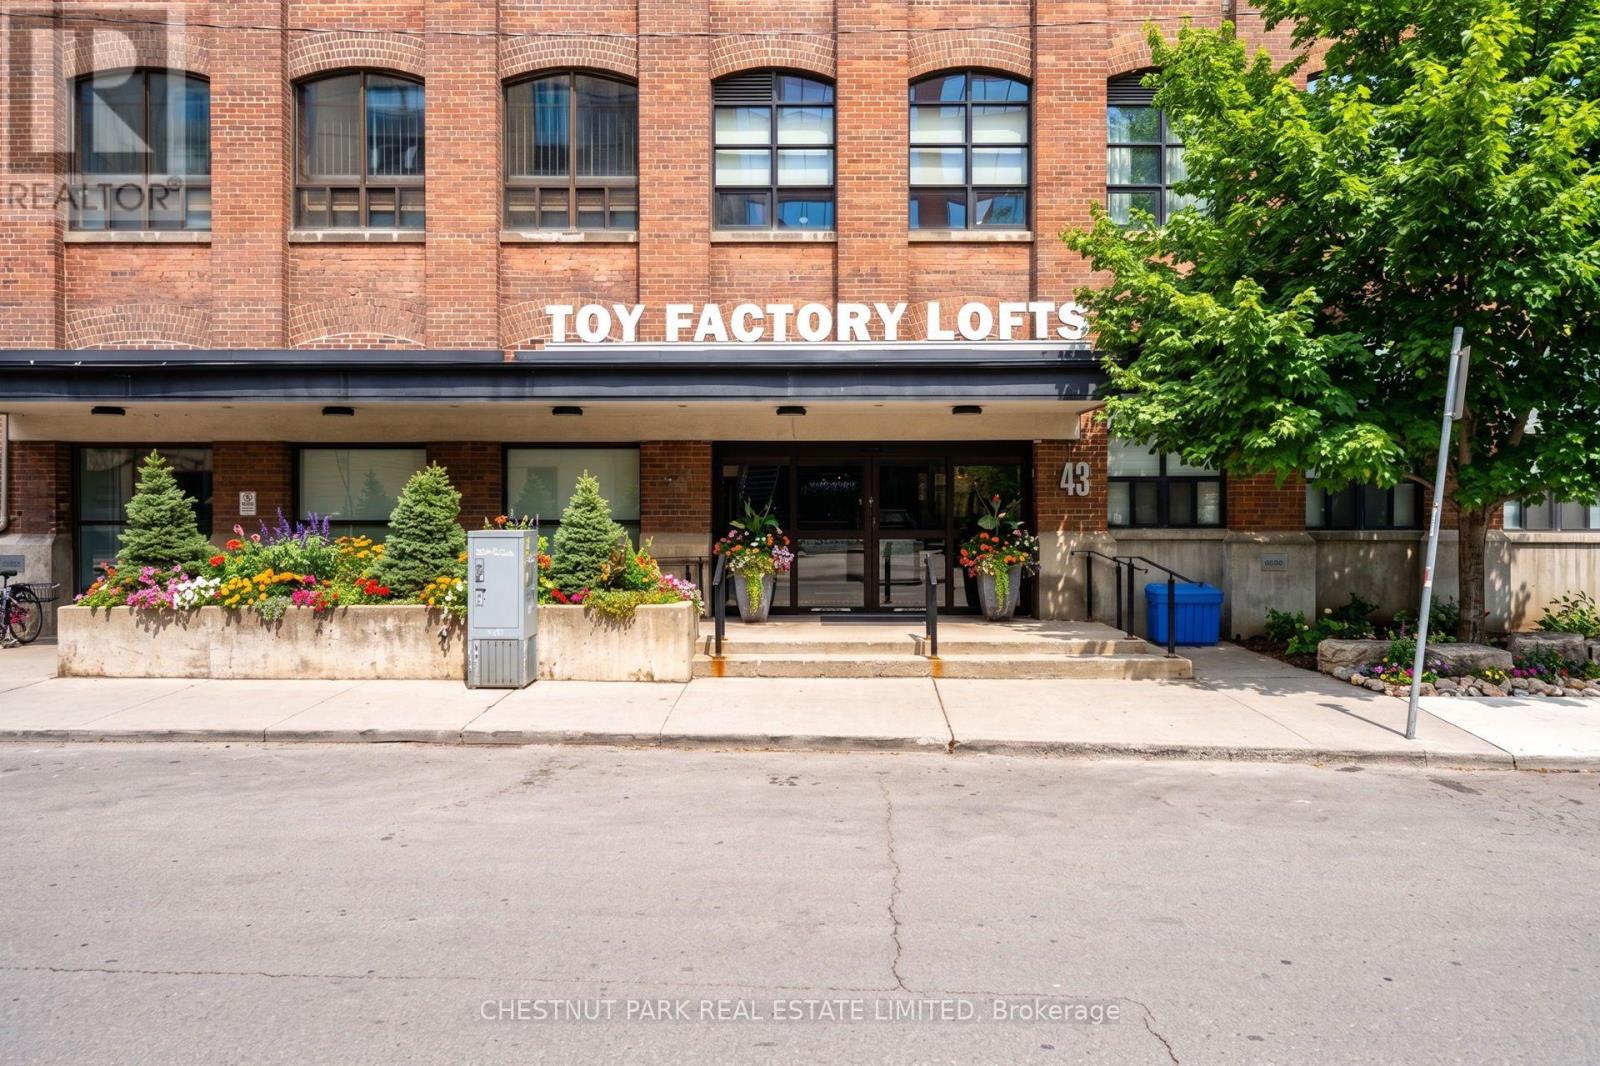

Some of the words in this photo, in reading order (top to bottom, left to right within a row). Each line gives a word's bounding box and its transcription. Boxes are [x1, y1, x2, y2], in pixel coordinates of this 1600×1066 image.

[545, 303, 645, 343] TOY
[665, 302, 908, 343] FACTORY
[926, 302, 1089, 340] LOFTS
[1060, 462, 1090, 497] 43
